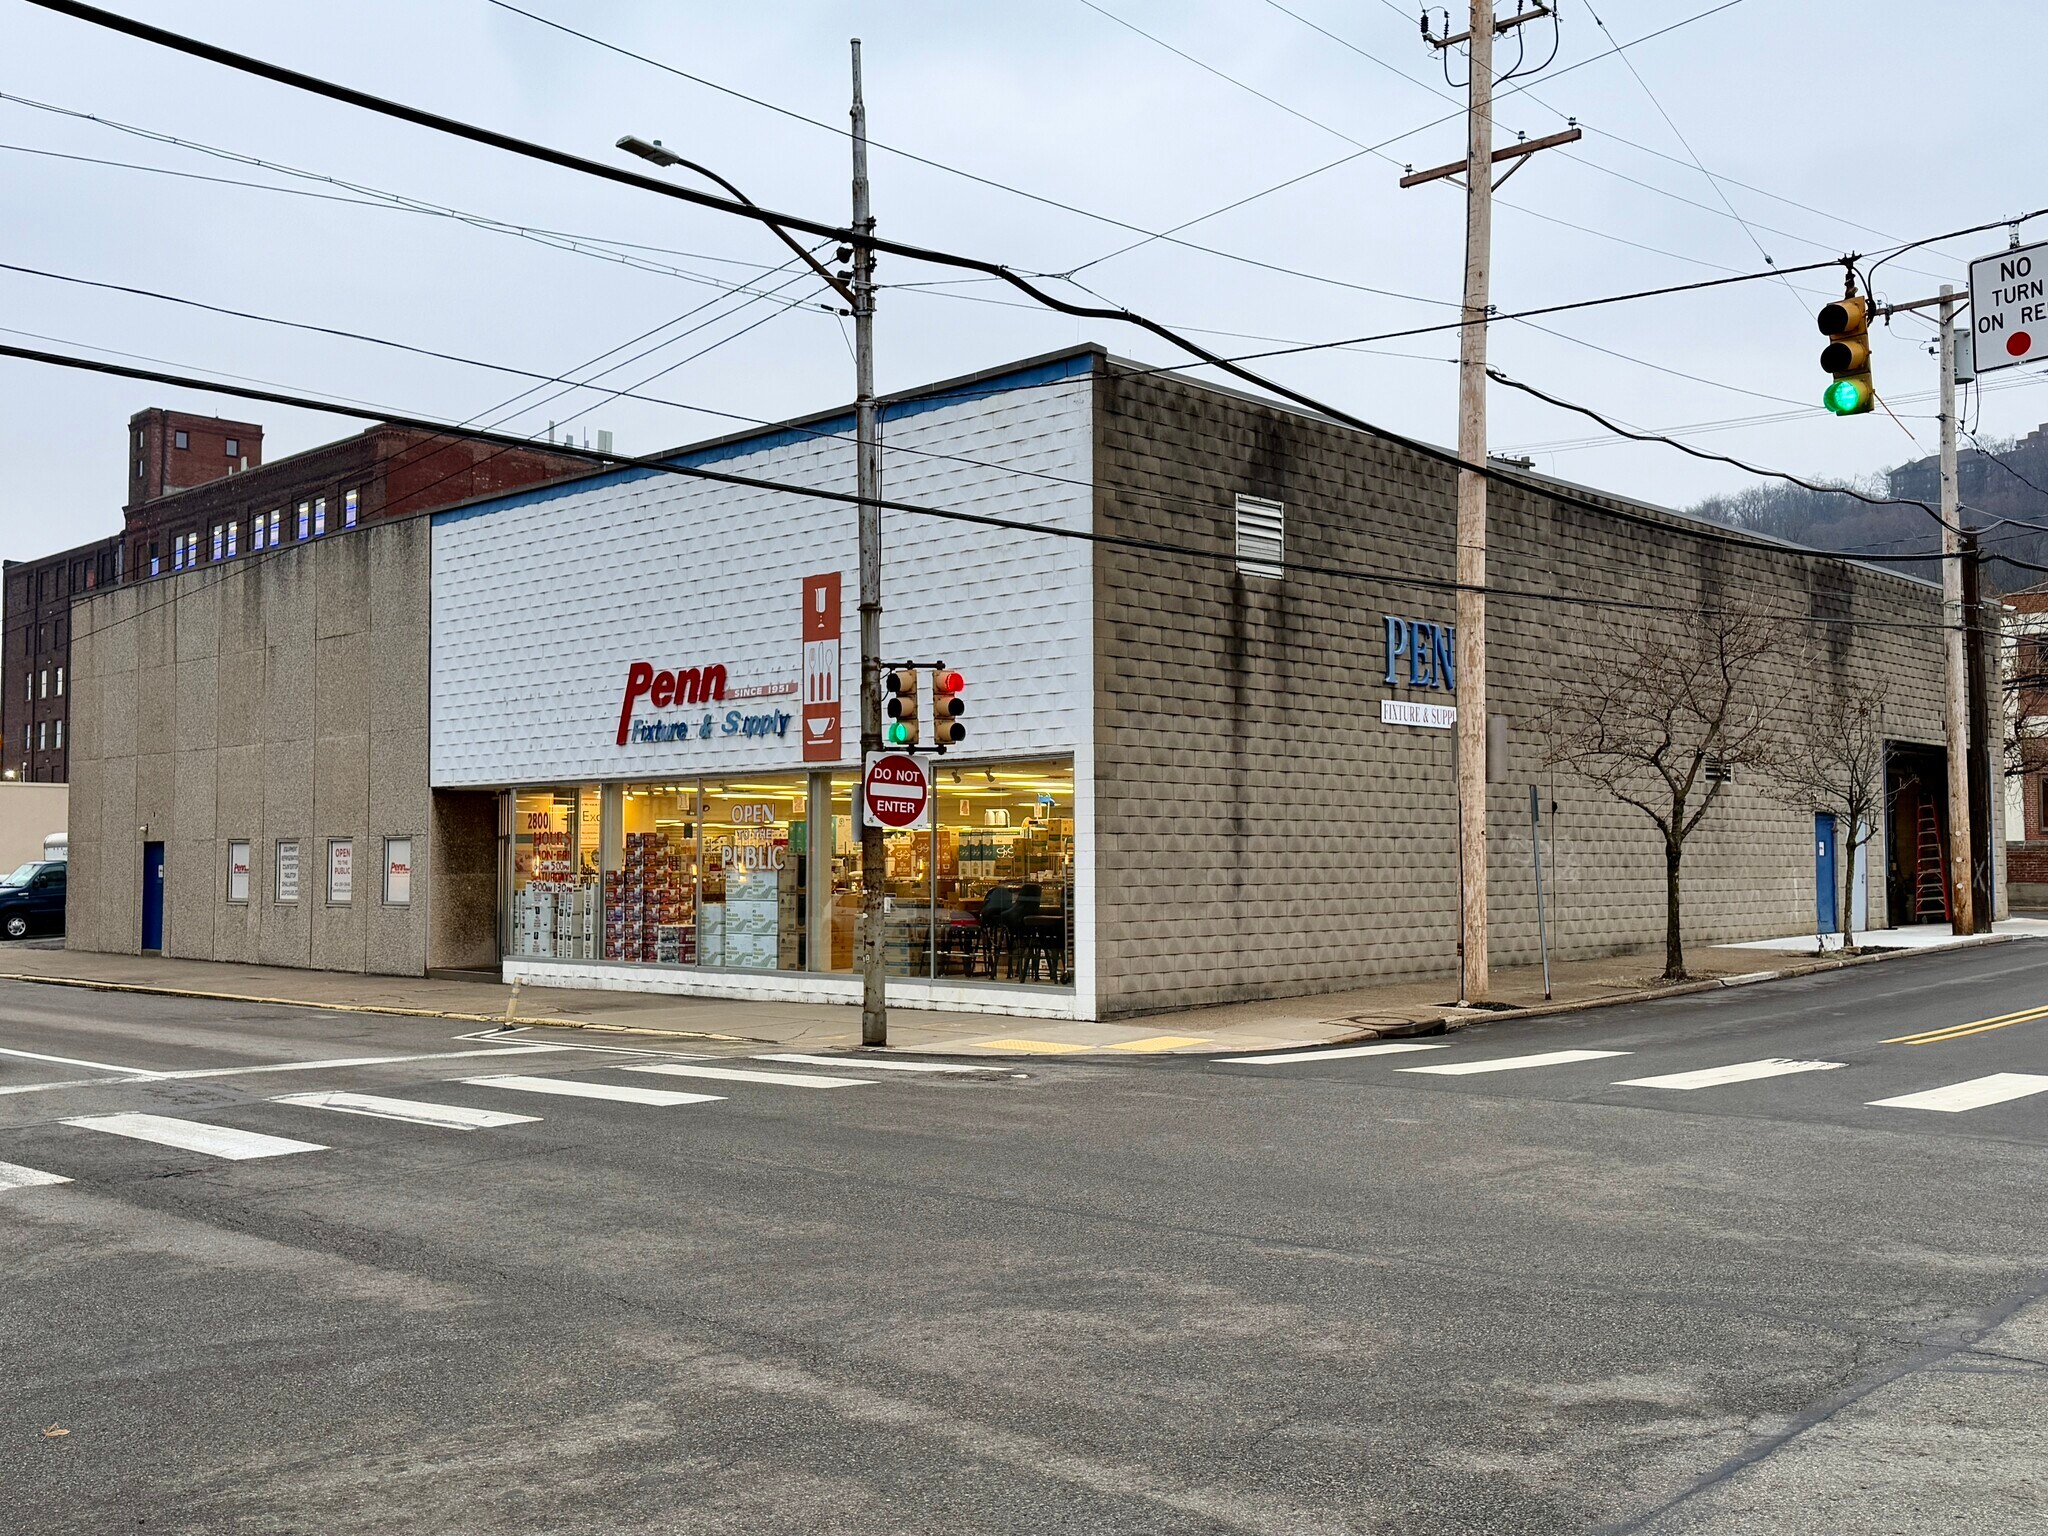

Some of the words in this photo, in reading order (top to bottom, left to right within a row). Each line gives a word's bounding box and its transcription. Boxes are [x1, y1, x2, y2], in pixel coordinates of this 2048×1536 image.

[2000, 257, 2032, 282] NO
[1992, 279, 2044, 307] TURN
[1978, 312, 2004, 334] ON
[2021, 302, 2048, 324] RE
[734, 686, 763, 698] SINCE
[768, 683, 790, 695] 1951
[616, 661, 728, 746] Penn
[1383, 703, 1421, 723] FIXTURE
[1423, 707, 1429, 723] &
[631, 719, 689, 743] Fixture
[698, 713, 712, 739] &
[721, 708, 793, 739] Supply
[874, 768, 892, 780] DO
[896, 769, 920, 783] NOT
[731, 803, 776, 824] OPEN
[876, 800, 915, 813] ENTER
[527, 811, 549, 830] 2800
[533, 831, 572, 846] HOURS
[736, 829, 749, 841] TO
[752, 828, 773, 840] THE
[335, 848, 351, 858] OPEN
[721, 845, 785, 870] PUBLIC
[334, 866, 351, 875] PUBLIC
[390, 861, 406, 874] Penn
